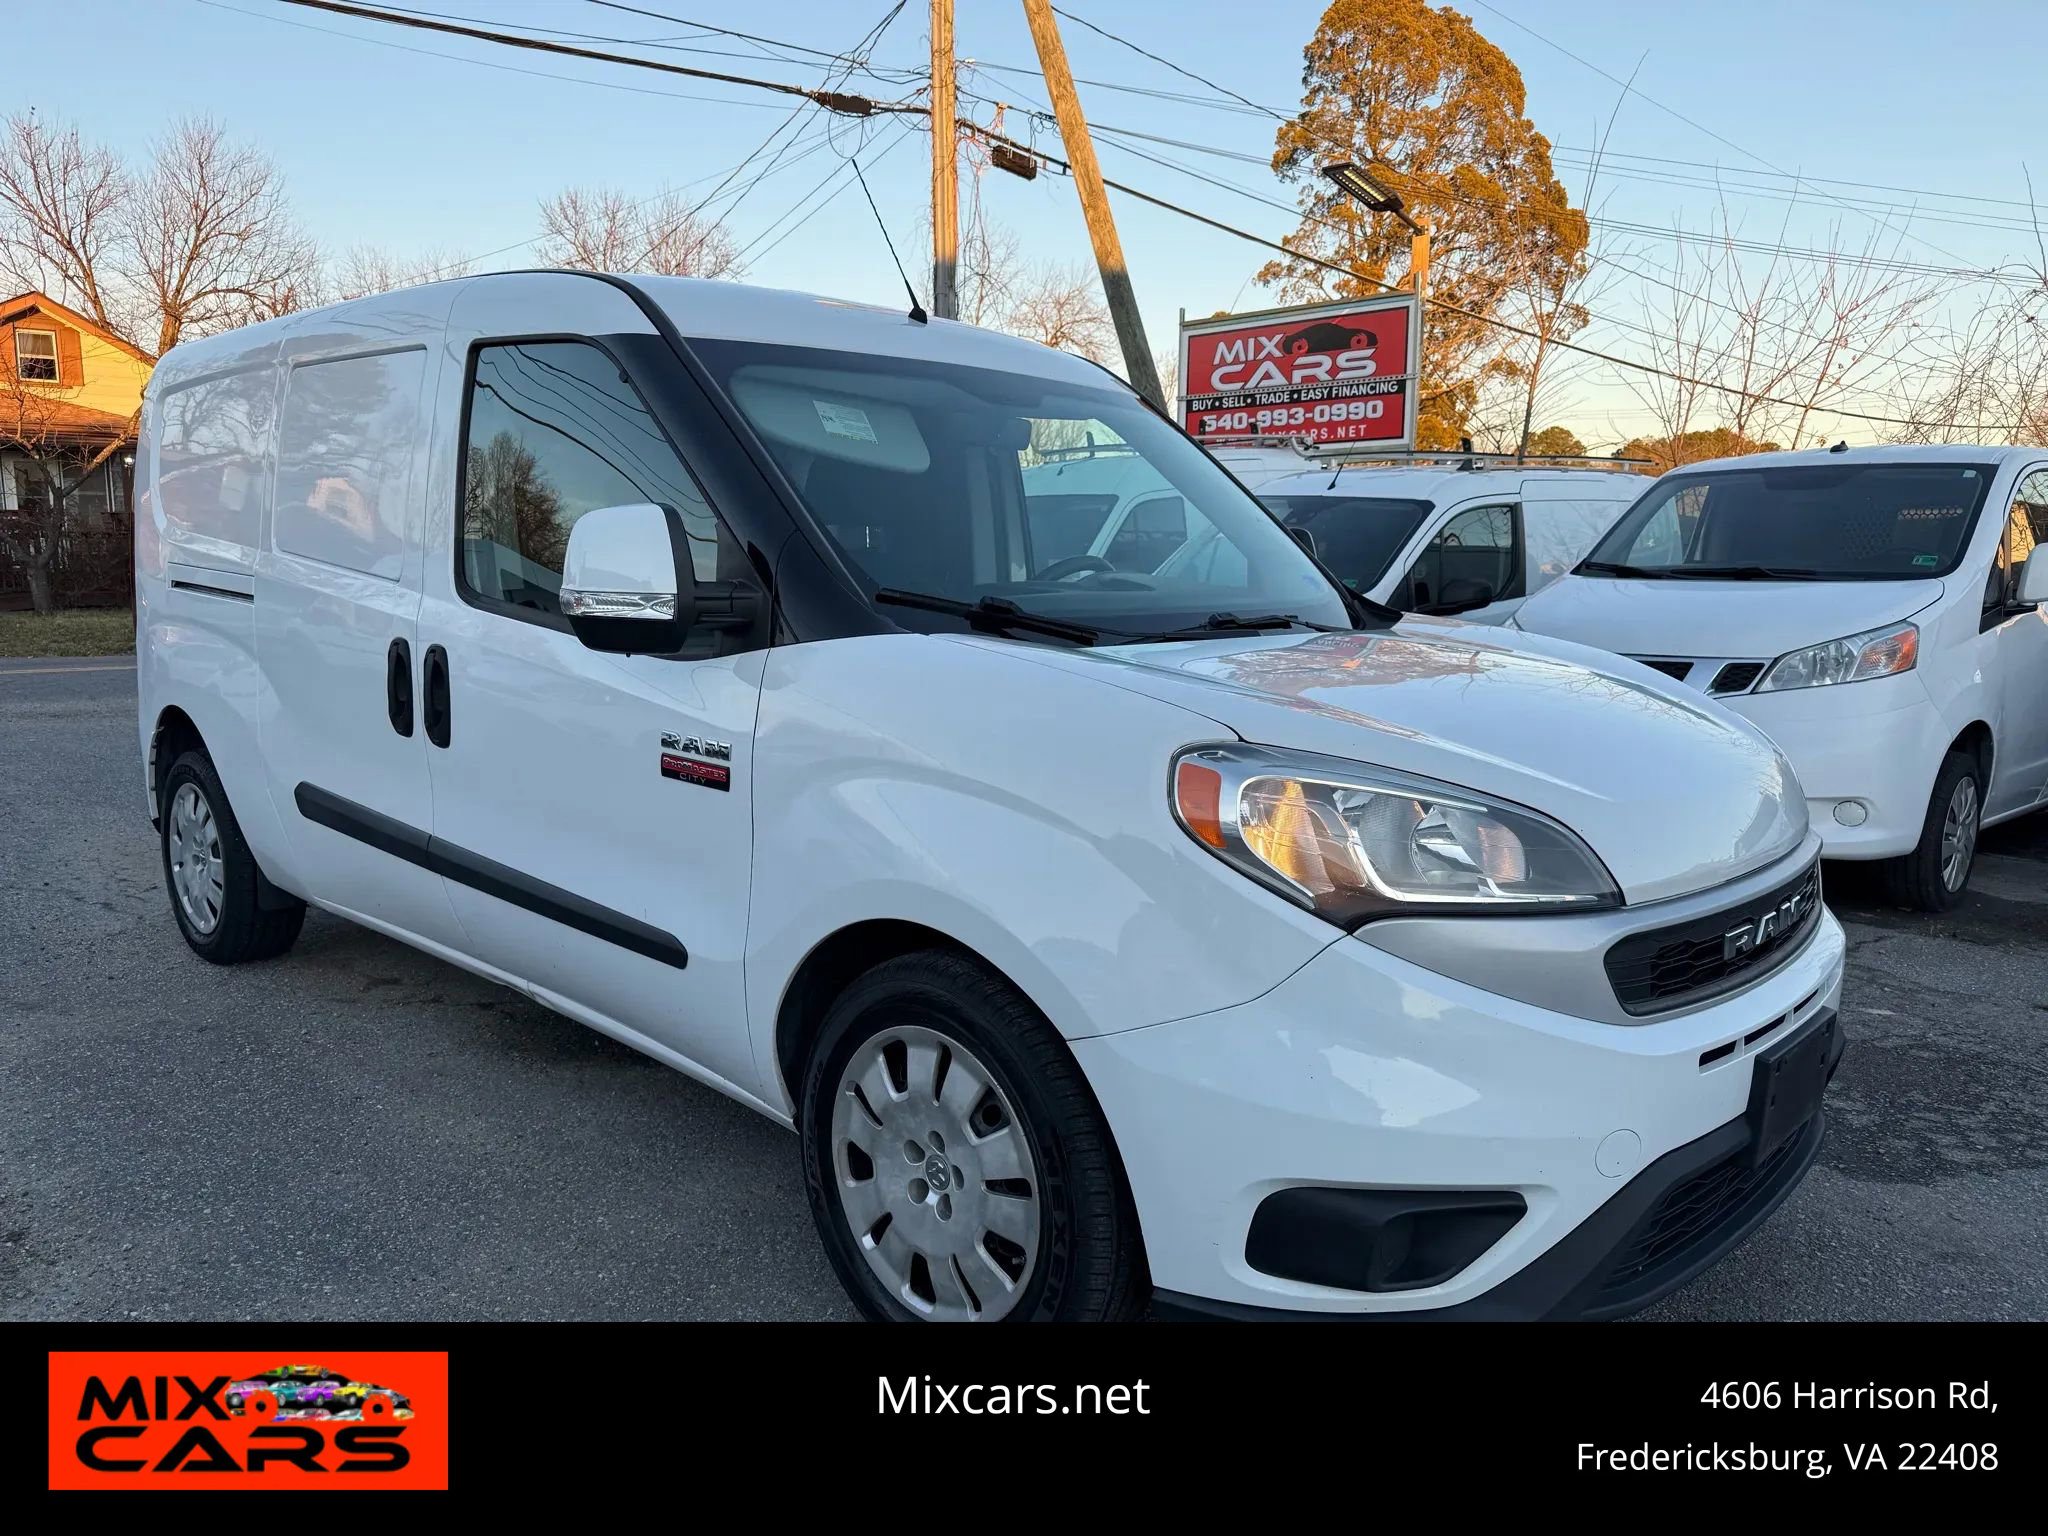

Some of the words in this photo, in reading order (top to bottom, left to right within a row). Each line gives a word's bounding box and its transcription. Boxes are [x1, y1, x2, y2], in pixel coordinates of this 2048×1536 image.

[1213, 333, 1285, 365] MIX
[1210, 348, 1377, 392] CARS
[1192, 399, 1214, 411] BUY
[1222, 396, 1246, 409] SELL
[1255, 391, 1290, 405] TRADE
[1300, 387, 1330, 400] EASY
[1331, 381, 1399, 398] FINANCING
[1202, 400, 1384, 432] 540-993-0990
[660, 730, 732, 761] RAM
[680, 772, 706, 784] CITY
